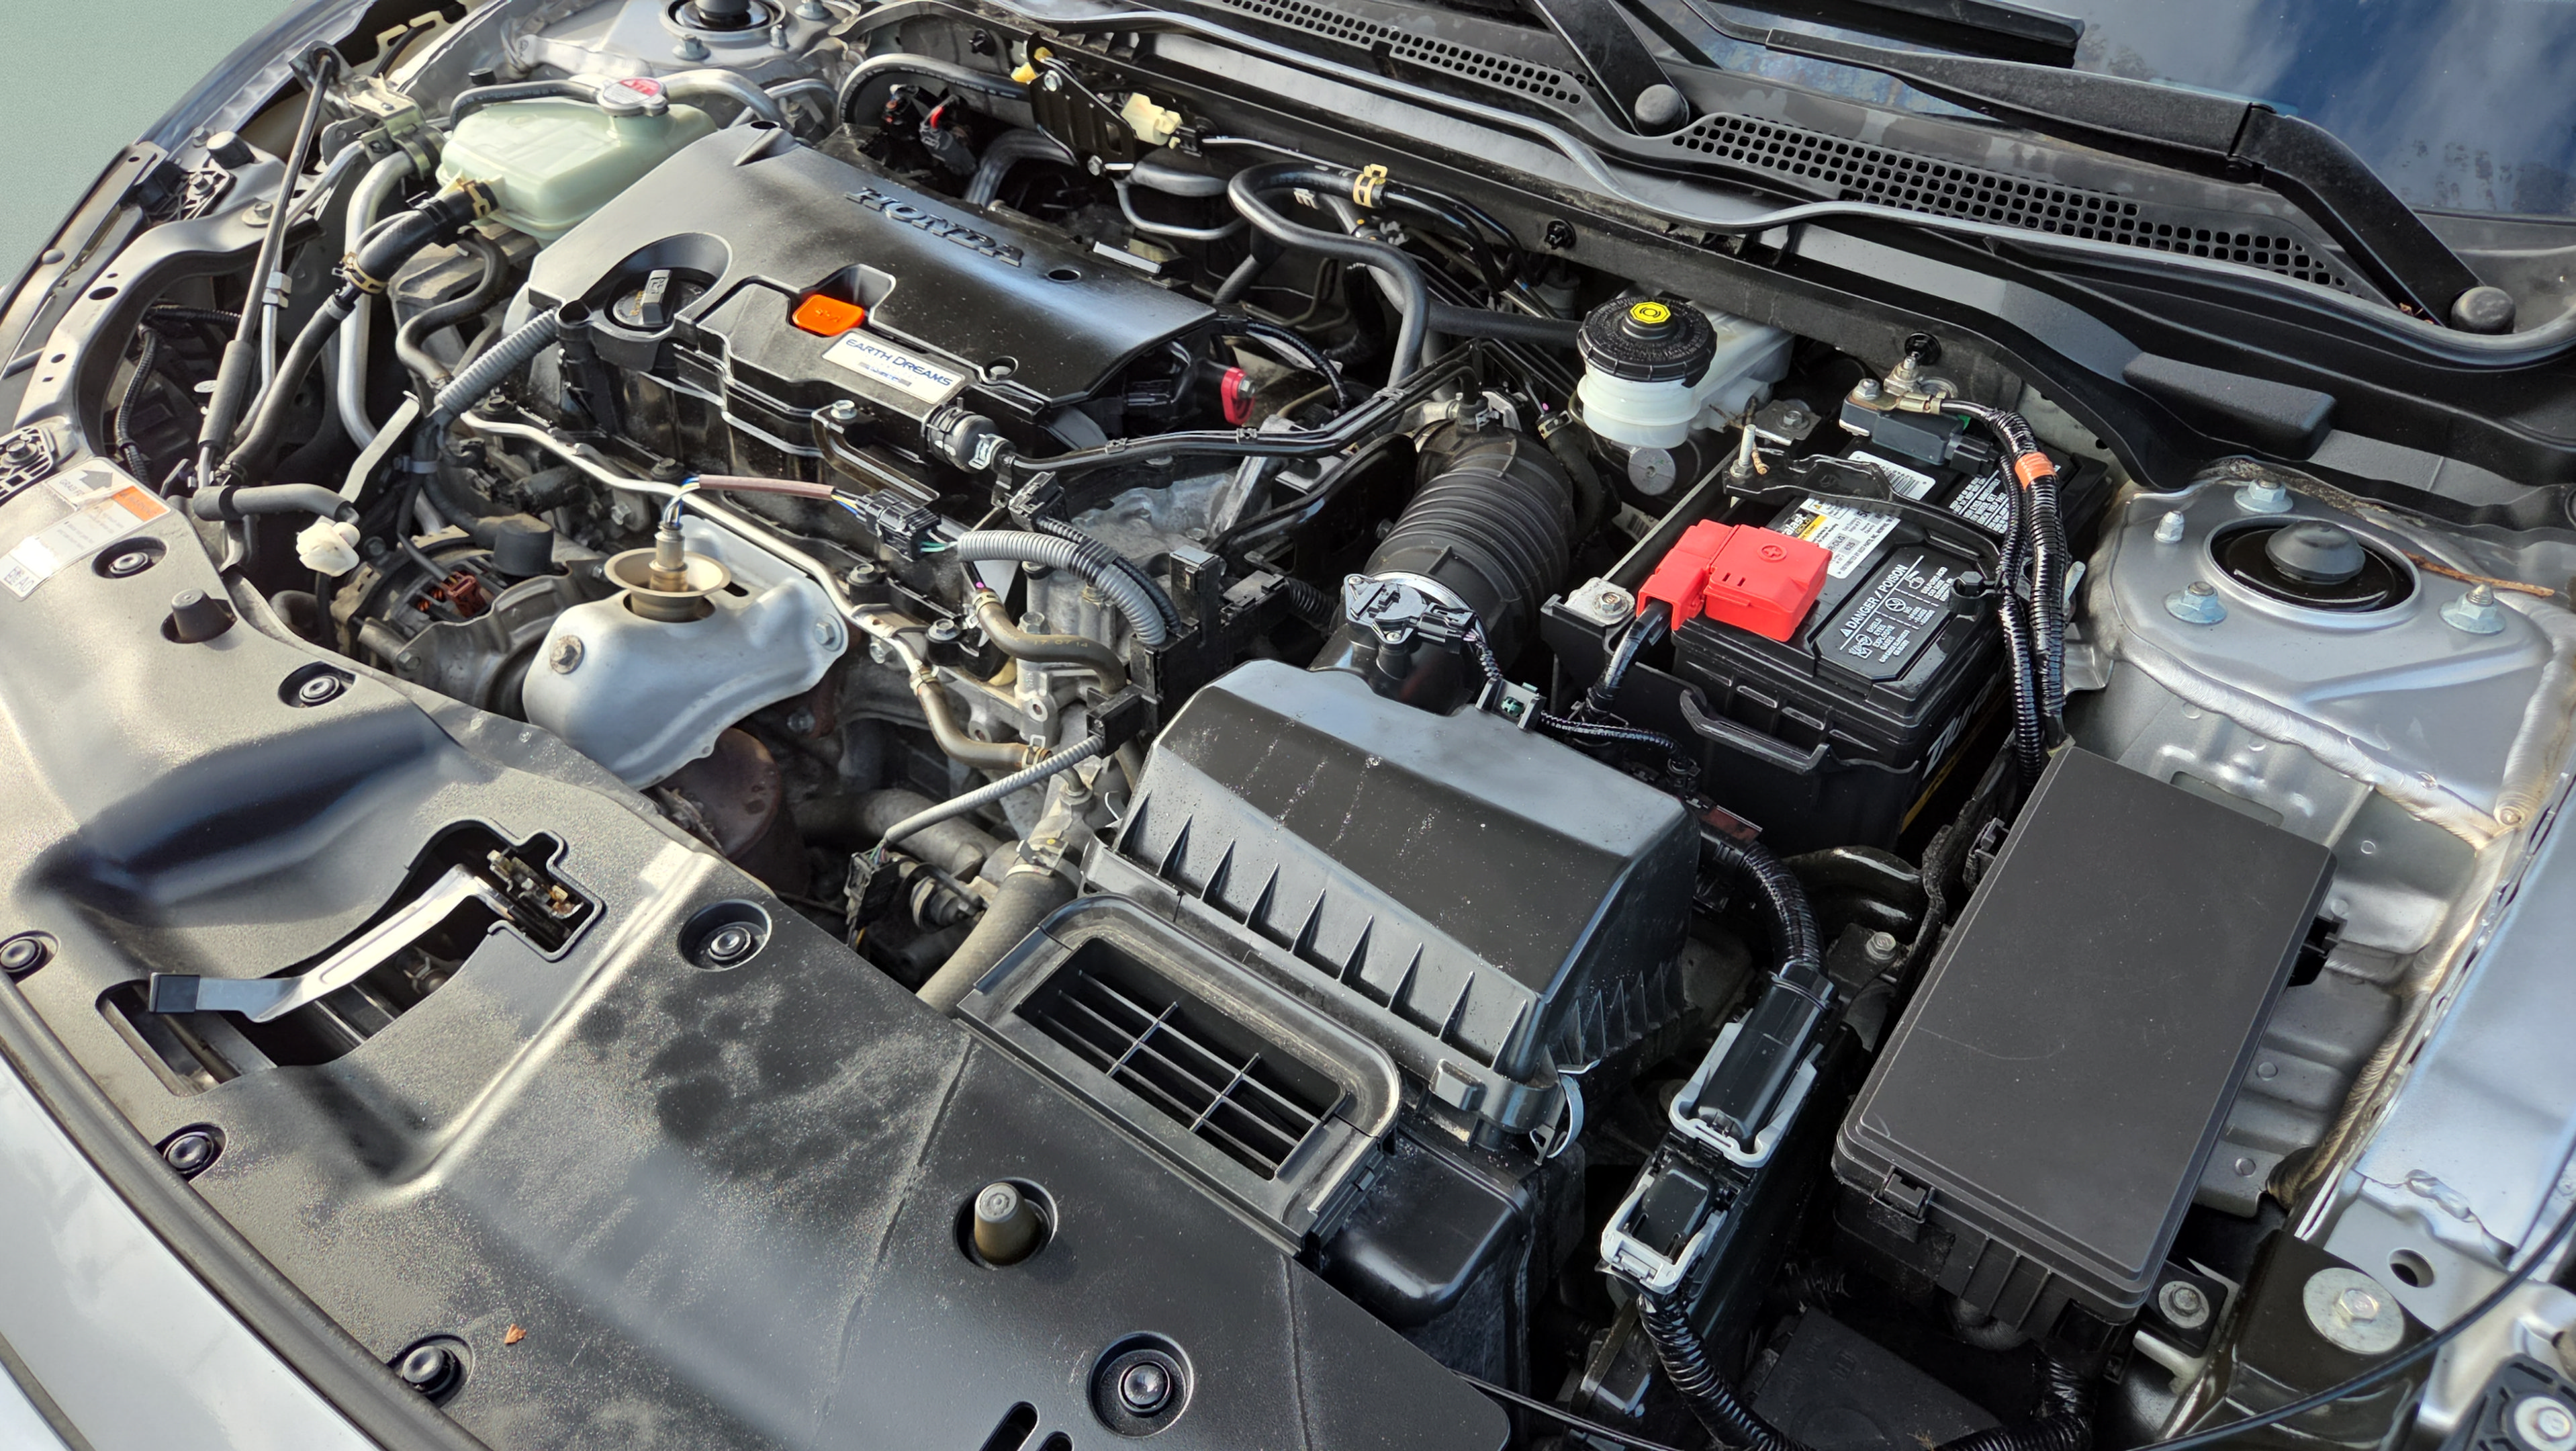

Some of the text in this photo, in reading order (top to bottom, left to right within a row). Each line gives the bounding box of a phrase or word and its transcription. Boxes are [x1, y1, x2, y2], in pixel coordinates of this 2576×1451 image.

[843, 186, 1025, 267] HONDA
[845, 339, 893, 361] EARTH
[892, 355, 953, 386] DREAMS
[1844, 541, 1855, 551] 625
[1845, 597, 1879, 630] DANGER
[1878, 564, 1908, 593] POISON
[1873, 623, 1886, 635] EYES
